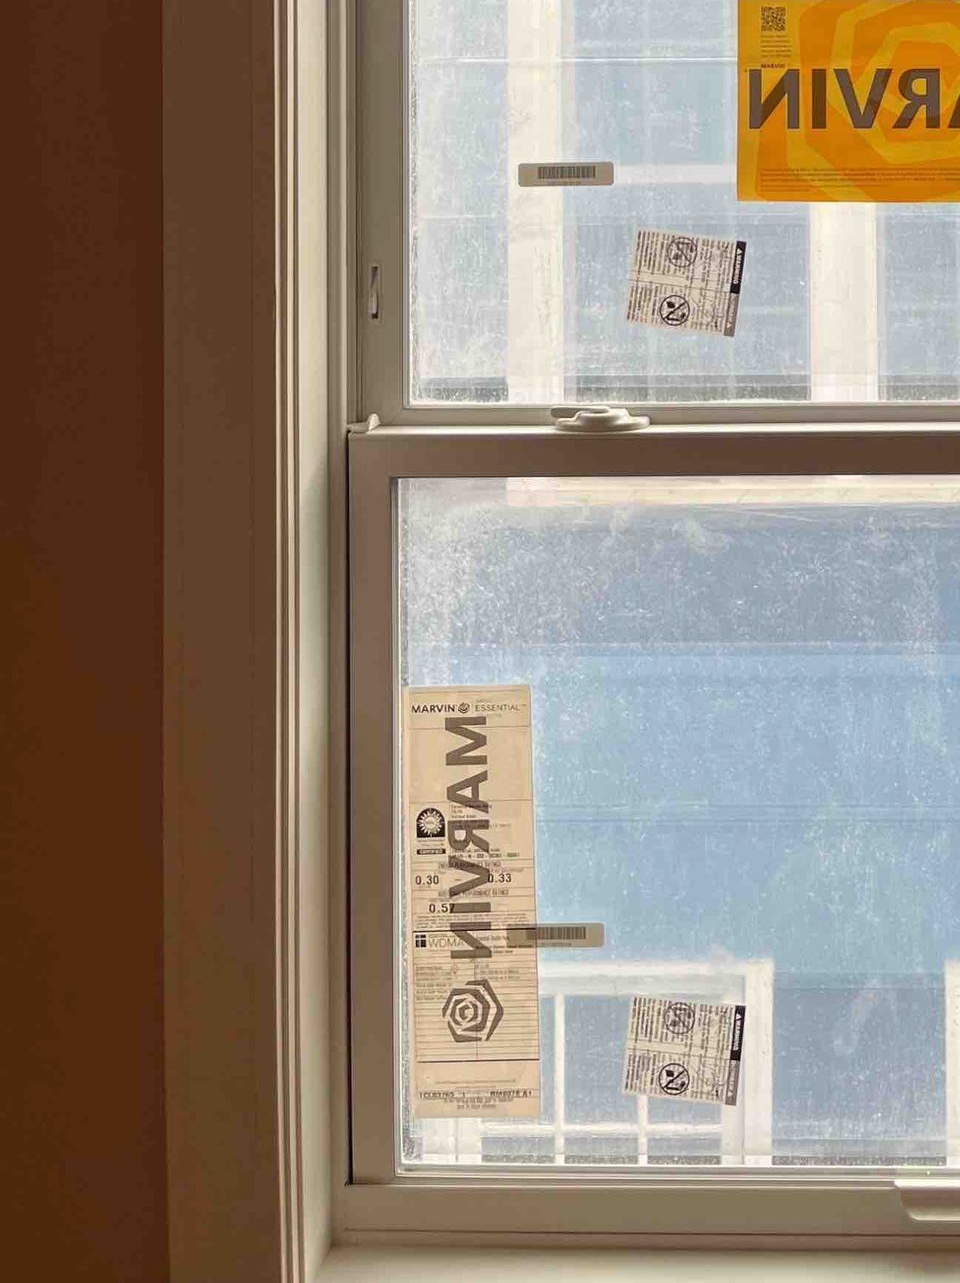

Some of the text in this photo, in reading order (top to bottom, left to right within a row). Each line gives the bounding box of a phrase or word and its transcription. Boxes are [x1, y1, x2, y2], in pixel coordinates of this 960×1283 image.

[411, 703, 520, 714] MARVIN ESSENTIAL
[415, 875, 440, 886] 0.30
[487, 872, 512, 884] 0.33
[428, 903, 455, 914] 0.57
[428, 938, 466, 948] WDMA
